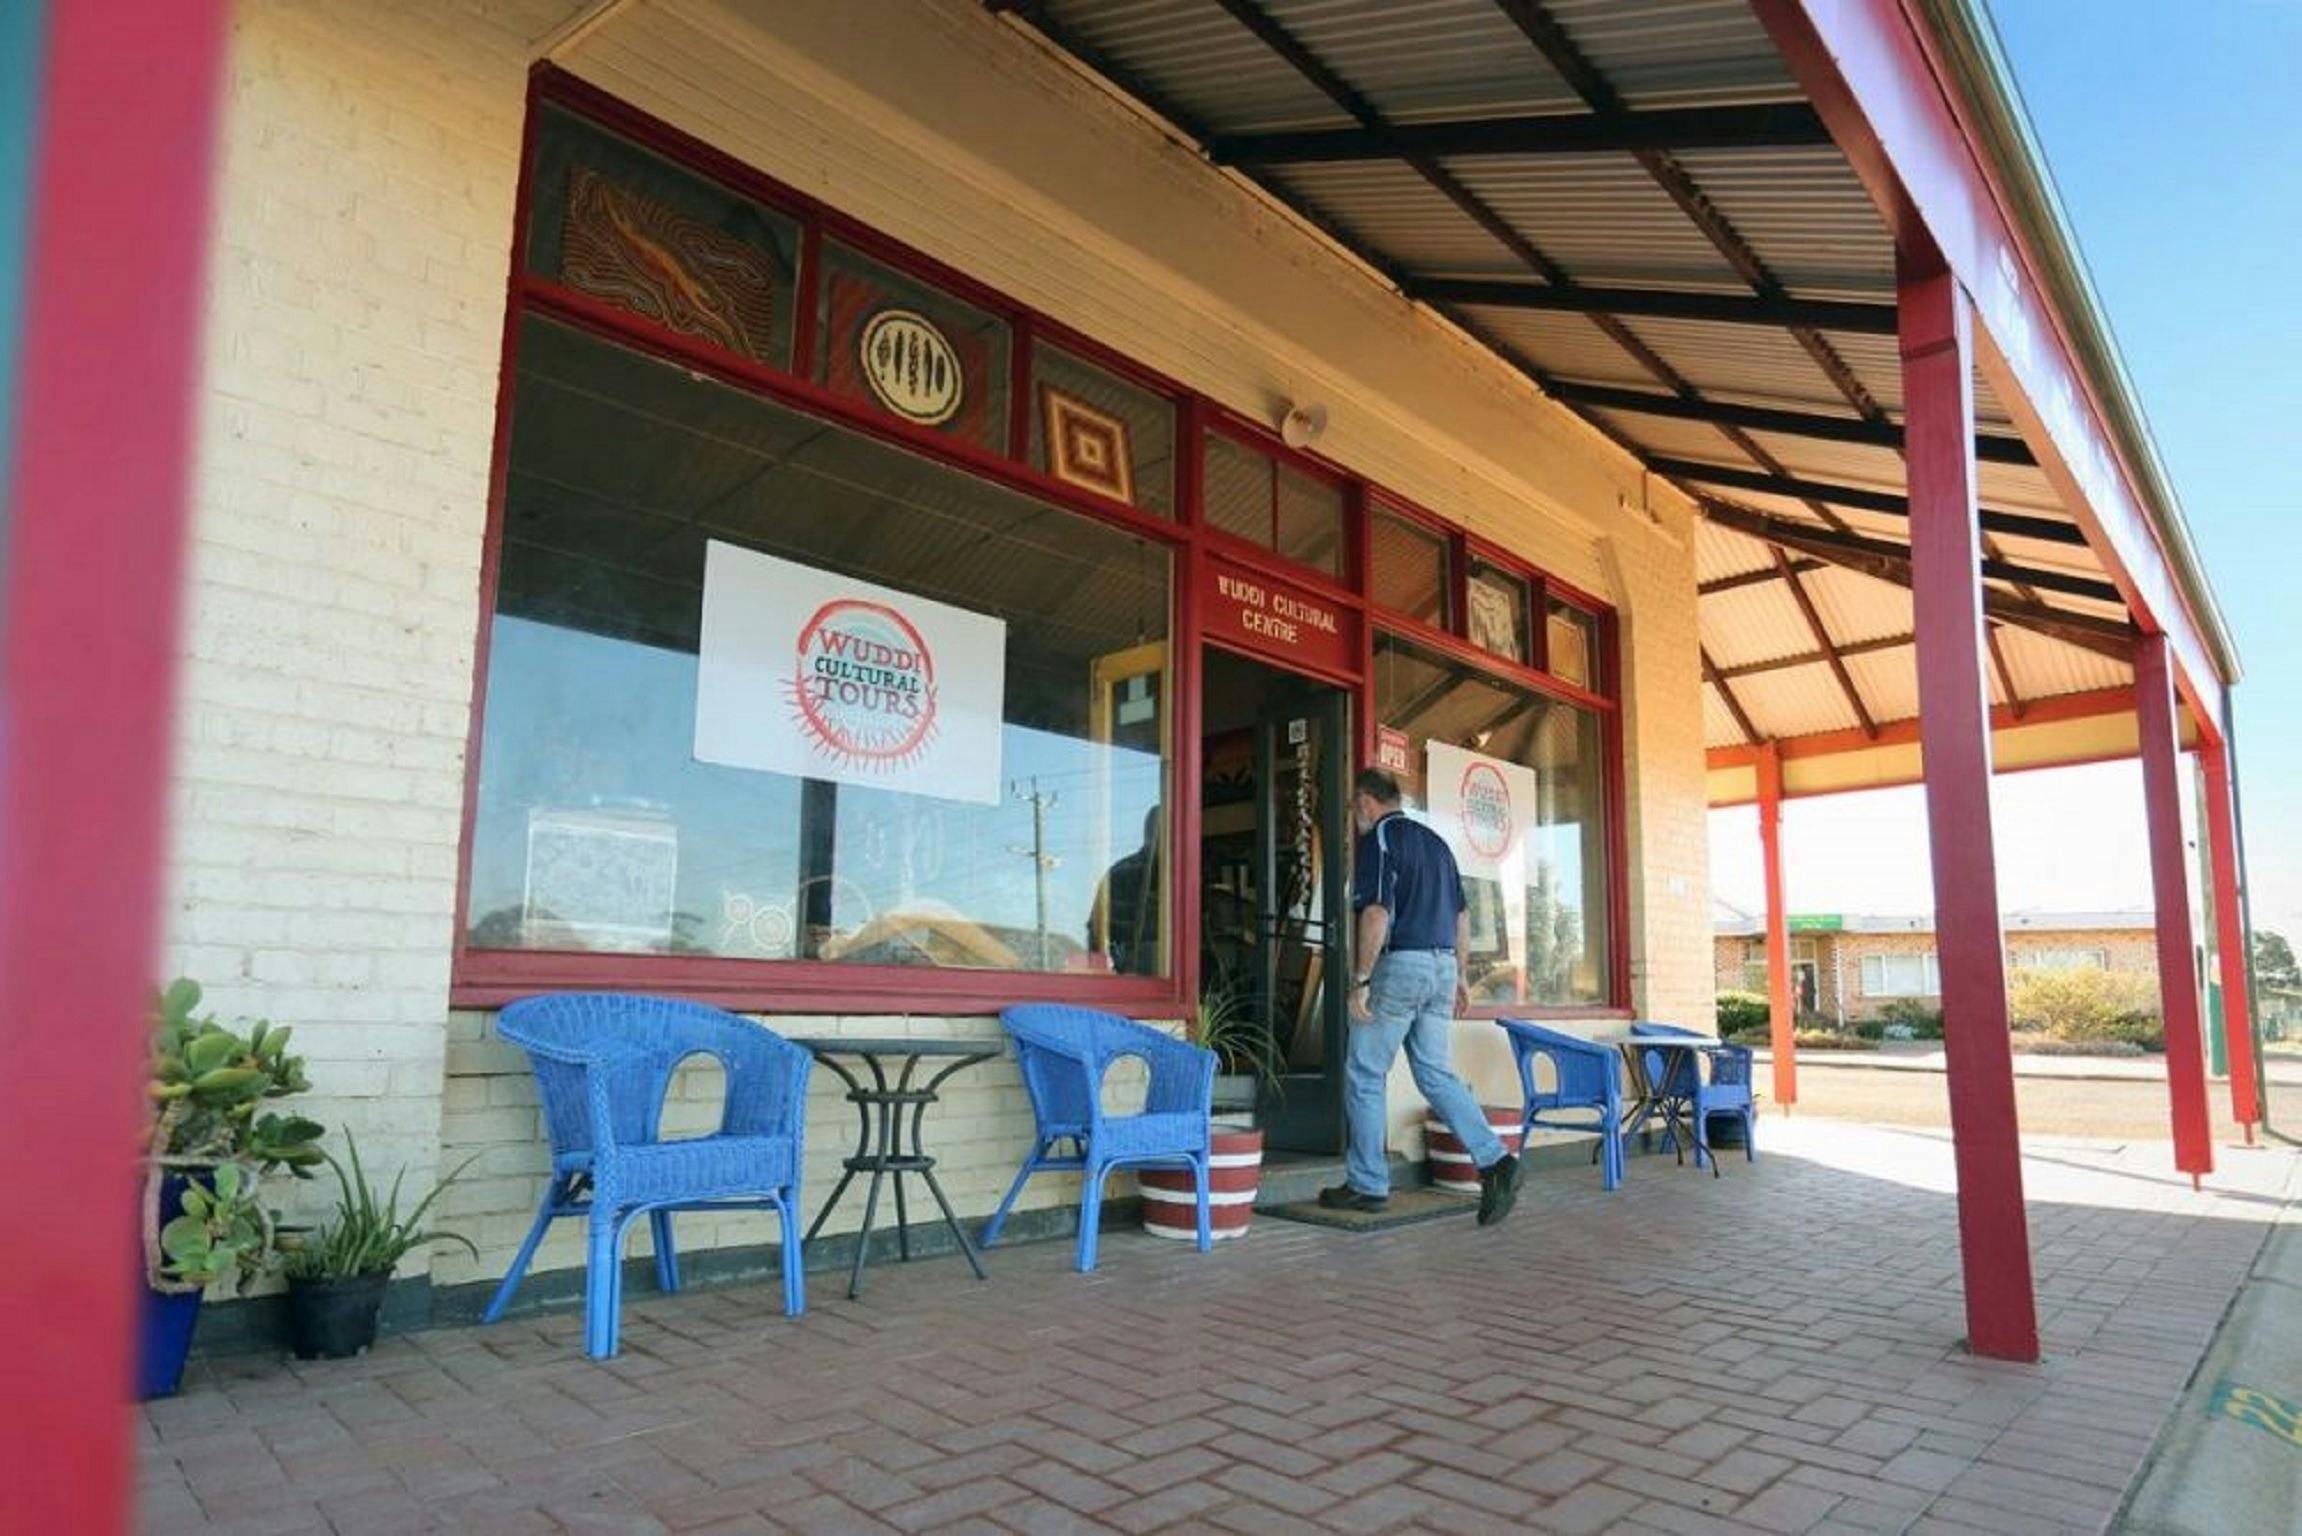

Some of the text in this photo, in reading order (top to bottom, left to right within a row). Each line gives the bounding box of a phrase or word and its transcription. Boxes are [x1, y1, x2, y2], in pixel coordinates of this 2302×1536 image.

[1218, 575, 1338, 634] WUDDI CULTURAL
[1242, 609, 1298, 643] CENTRE
[818, 627, 922, 674] WUDDI
[814, 656, 922, 693] CULTURAL
[815, 676, 922, 719] TOURS
